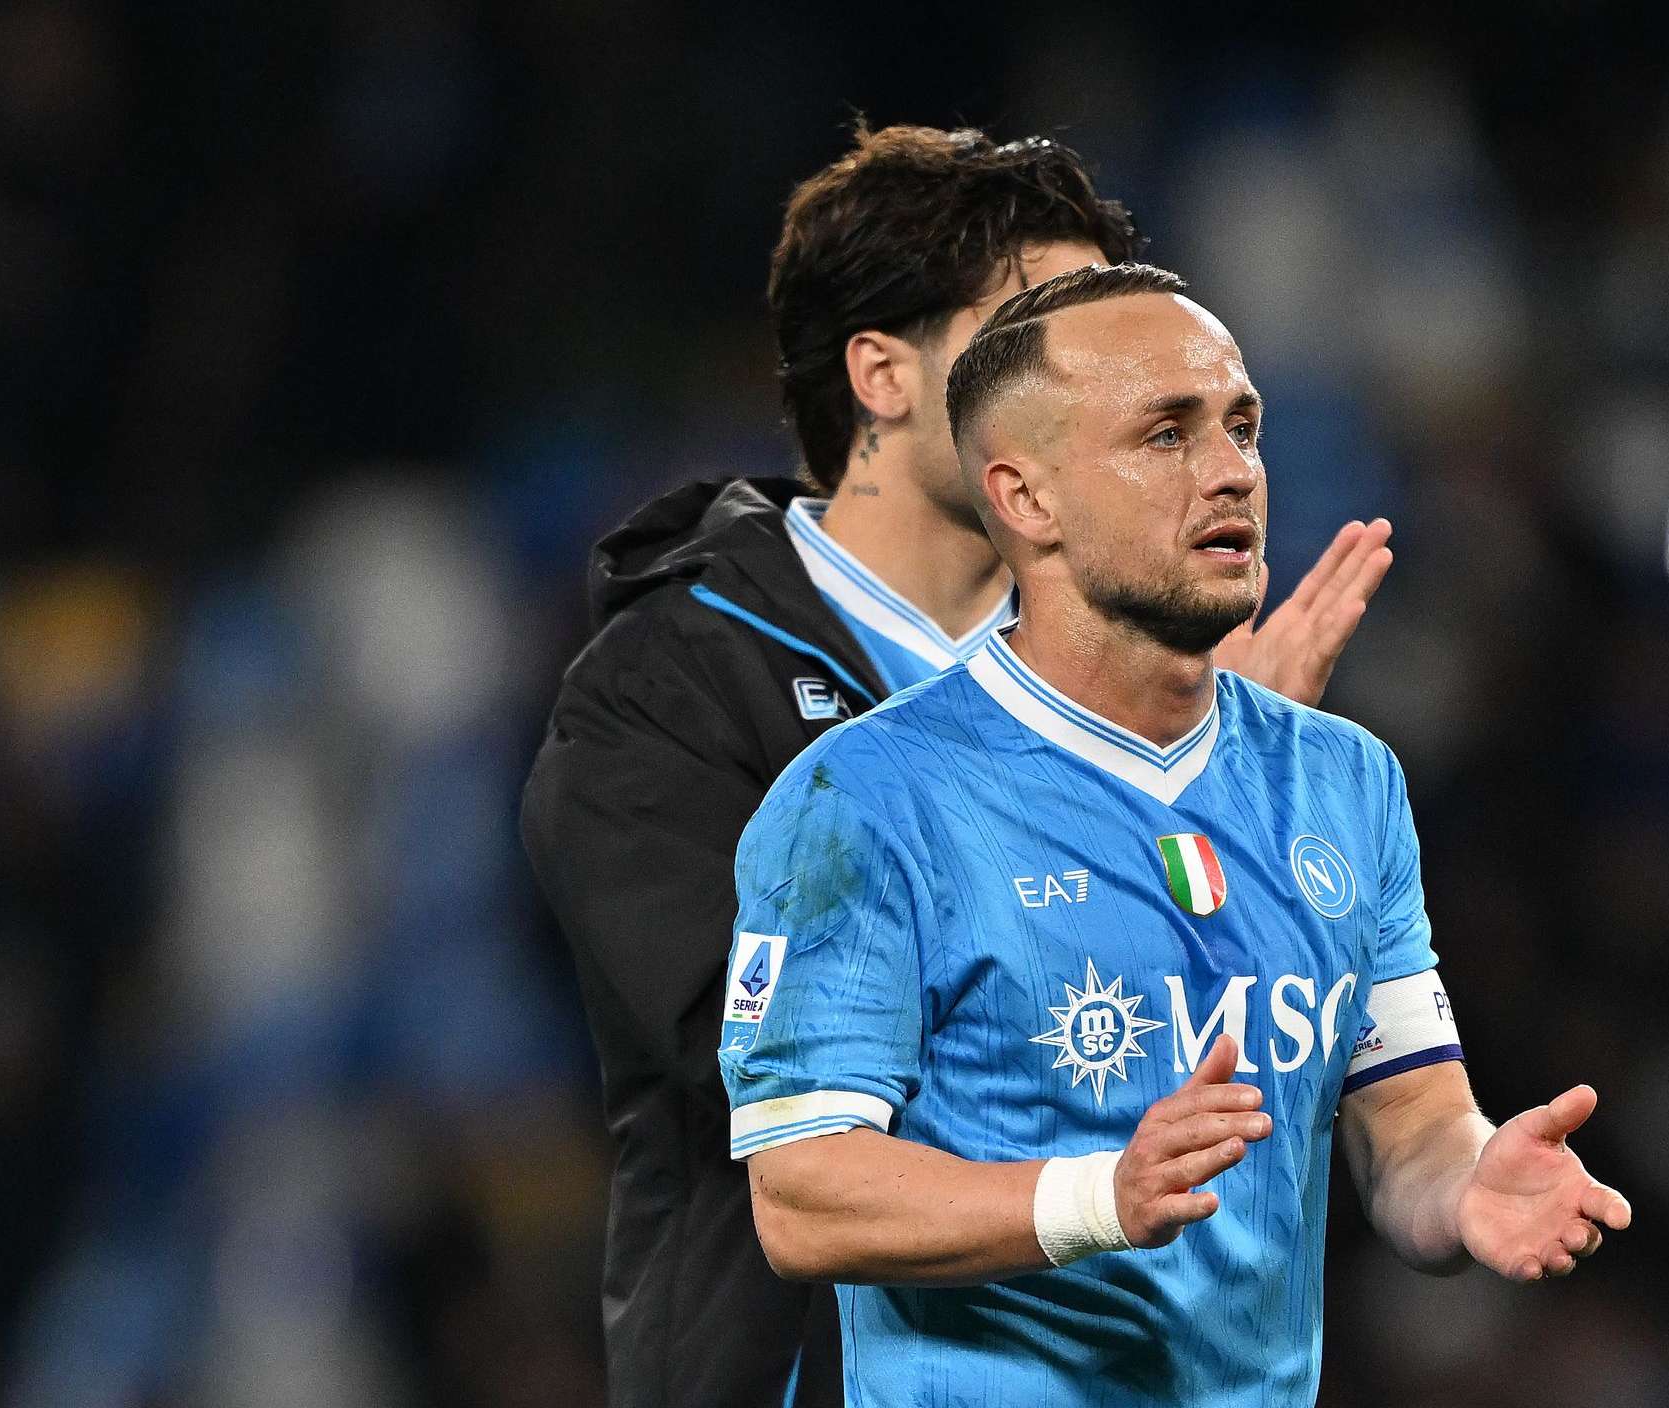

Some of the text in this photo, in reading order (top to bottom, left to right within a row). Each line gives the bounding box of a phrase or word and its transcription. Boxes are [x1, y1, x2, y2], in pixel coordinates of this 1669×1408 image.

[1013, 868, 1089, 908] EA7
[733, 998, 759, 1012] SERIE
[1352, 1040, 1374, 1054] ERIE
